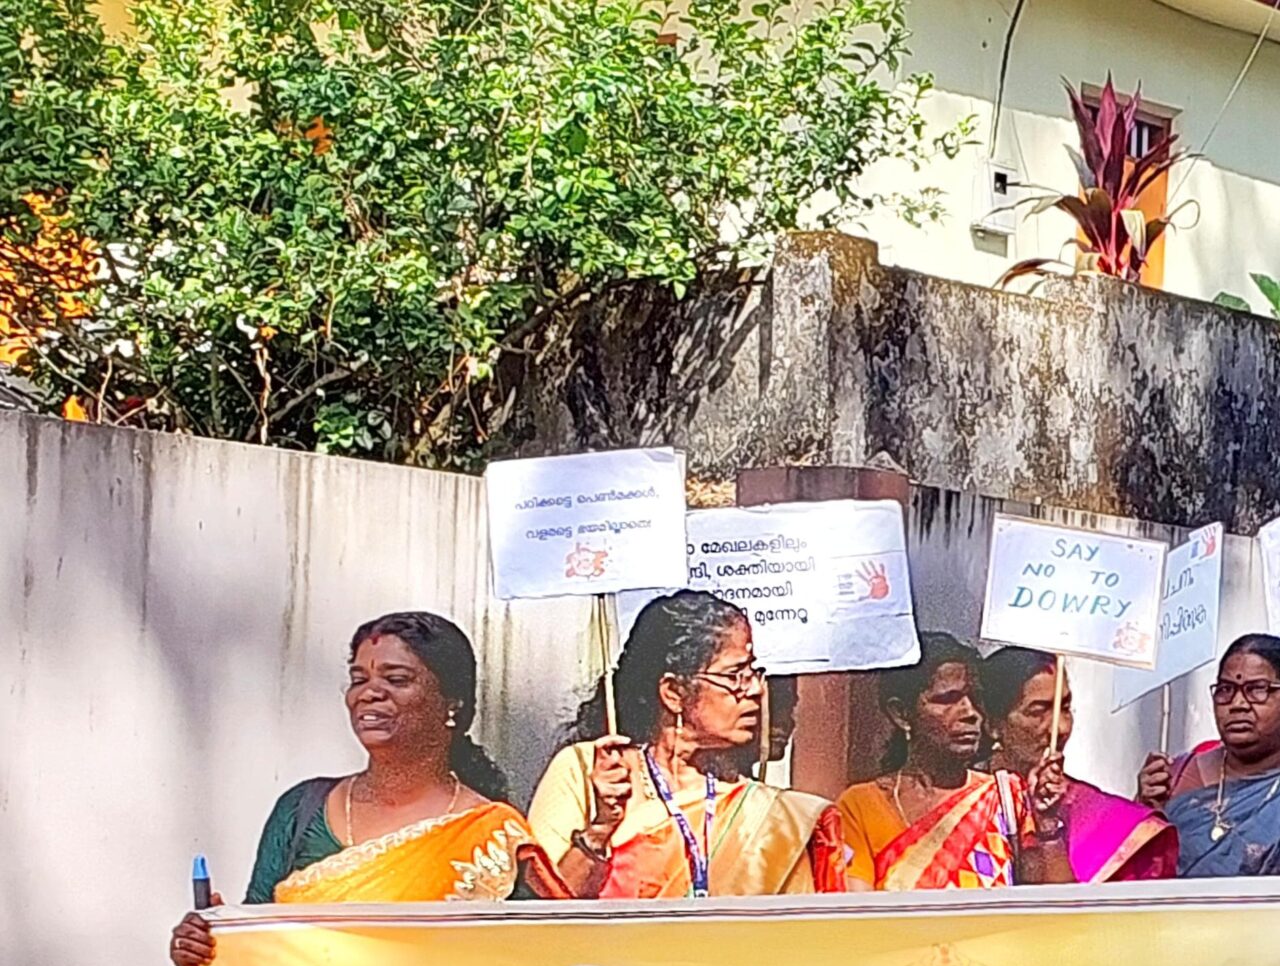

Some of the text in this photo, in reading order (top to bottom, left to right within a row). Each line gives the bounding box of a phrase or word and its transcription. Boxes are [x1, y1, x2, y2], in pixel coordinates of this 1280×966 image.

[701, 534, 807, 554] മേഖലകളിലും
[1051, 538, 1100, 561] SAY
[717, 556, 816, 577] ശക്തിയായി
[1023, 563, 1121, 588] NO TO
[1008, 586, 1133, 618] DOWRY
